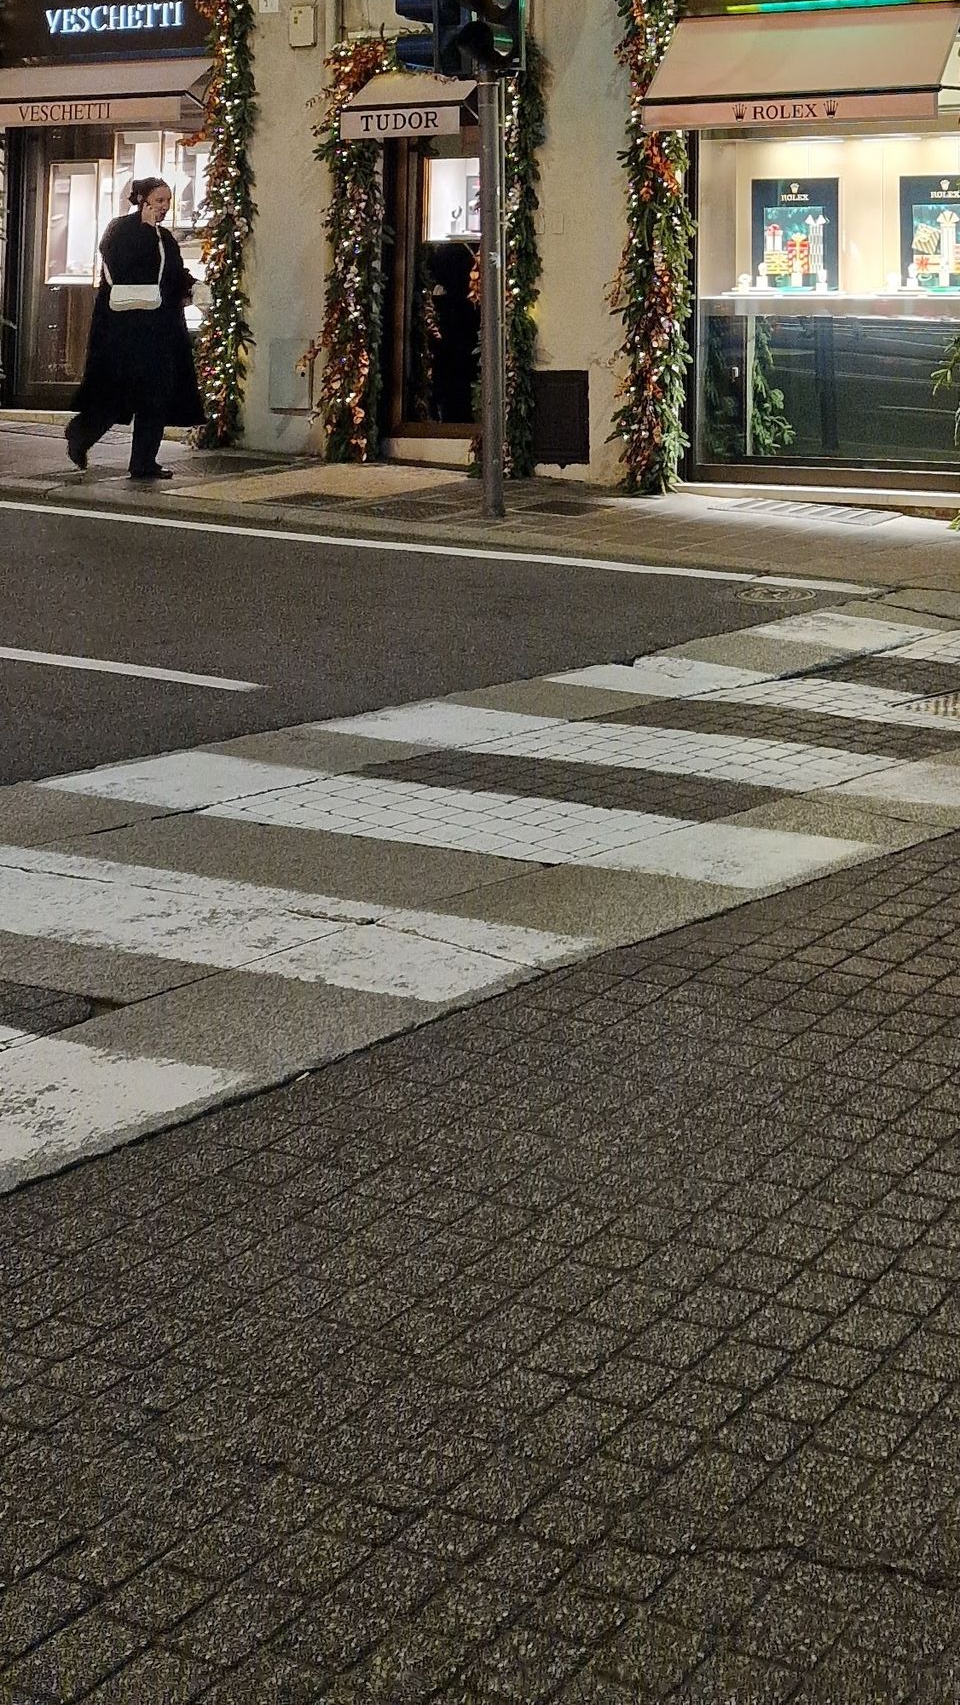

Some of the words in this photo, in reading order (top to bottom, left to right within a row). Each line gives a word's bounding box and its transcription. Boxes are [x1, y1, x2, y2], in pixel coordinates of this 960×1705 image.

[45, 0, 183, 34] VESCHETTI
[18, 103, 111, 122] VESCHETTI
[360, 111, 439, 132] TUDOR
[752, 104, 818, 120] ROLEX
[931, 190, 960, 199] ROLEX
